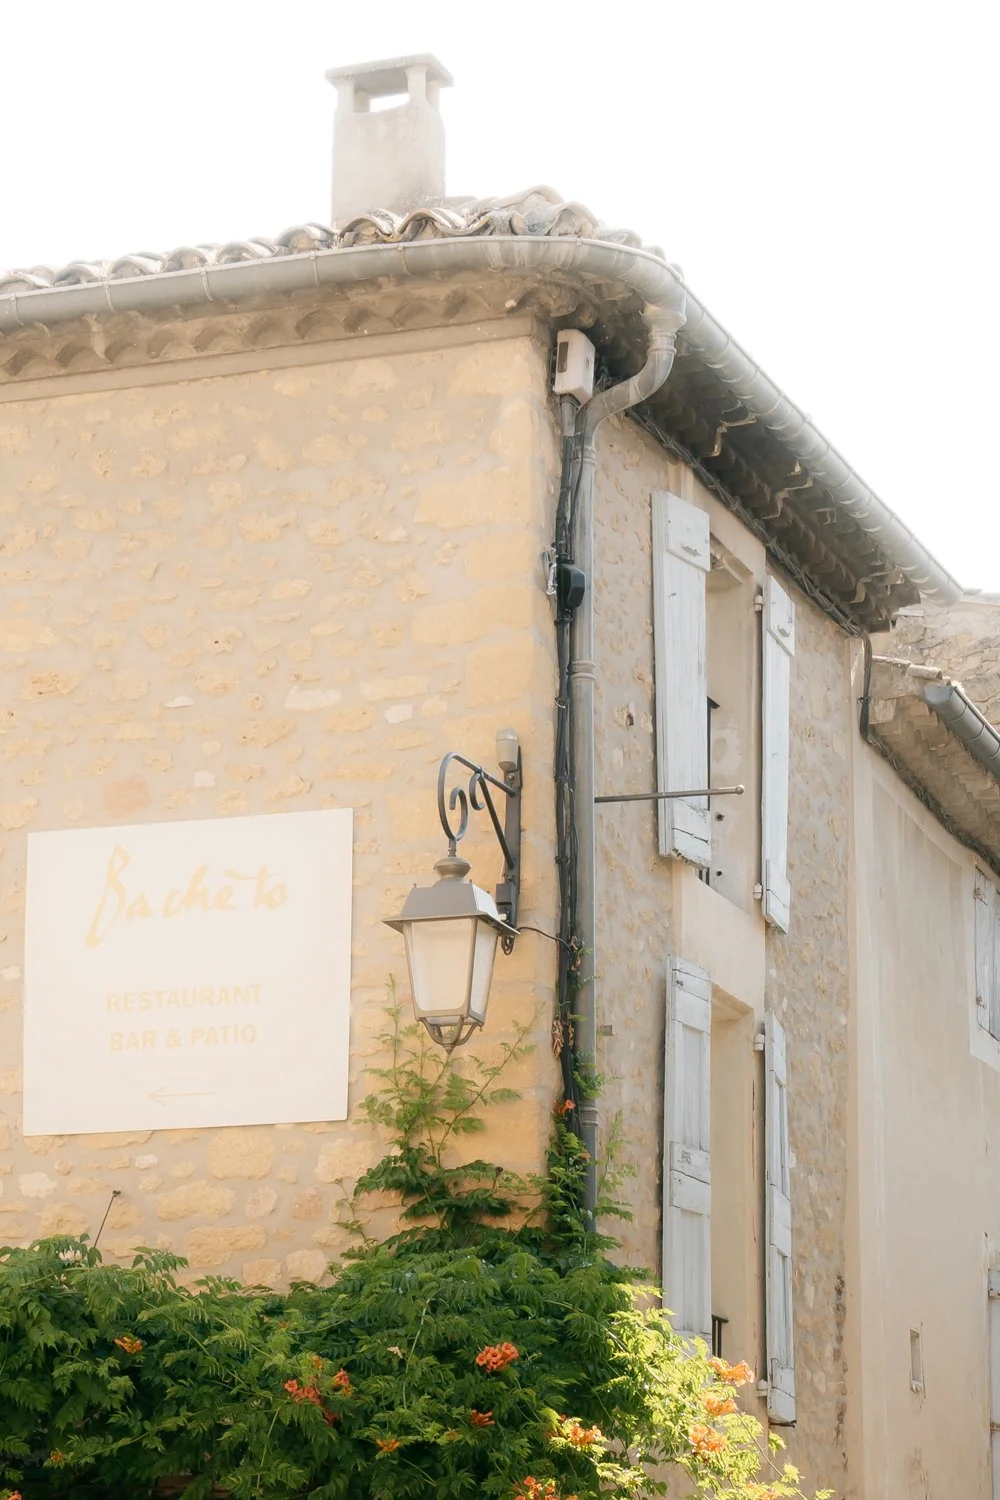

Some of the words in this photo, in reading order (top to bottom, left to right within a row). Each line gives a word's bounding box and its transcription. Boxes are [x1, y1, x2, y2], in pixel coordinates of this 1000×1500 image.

[105, 984, 263, 1014] RESTAURANT
[109, 1030, 157, 1053] BAR
[164, 1027, 181, 1050] &
[190, 1024, 258, 1047] PATIO
